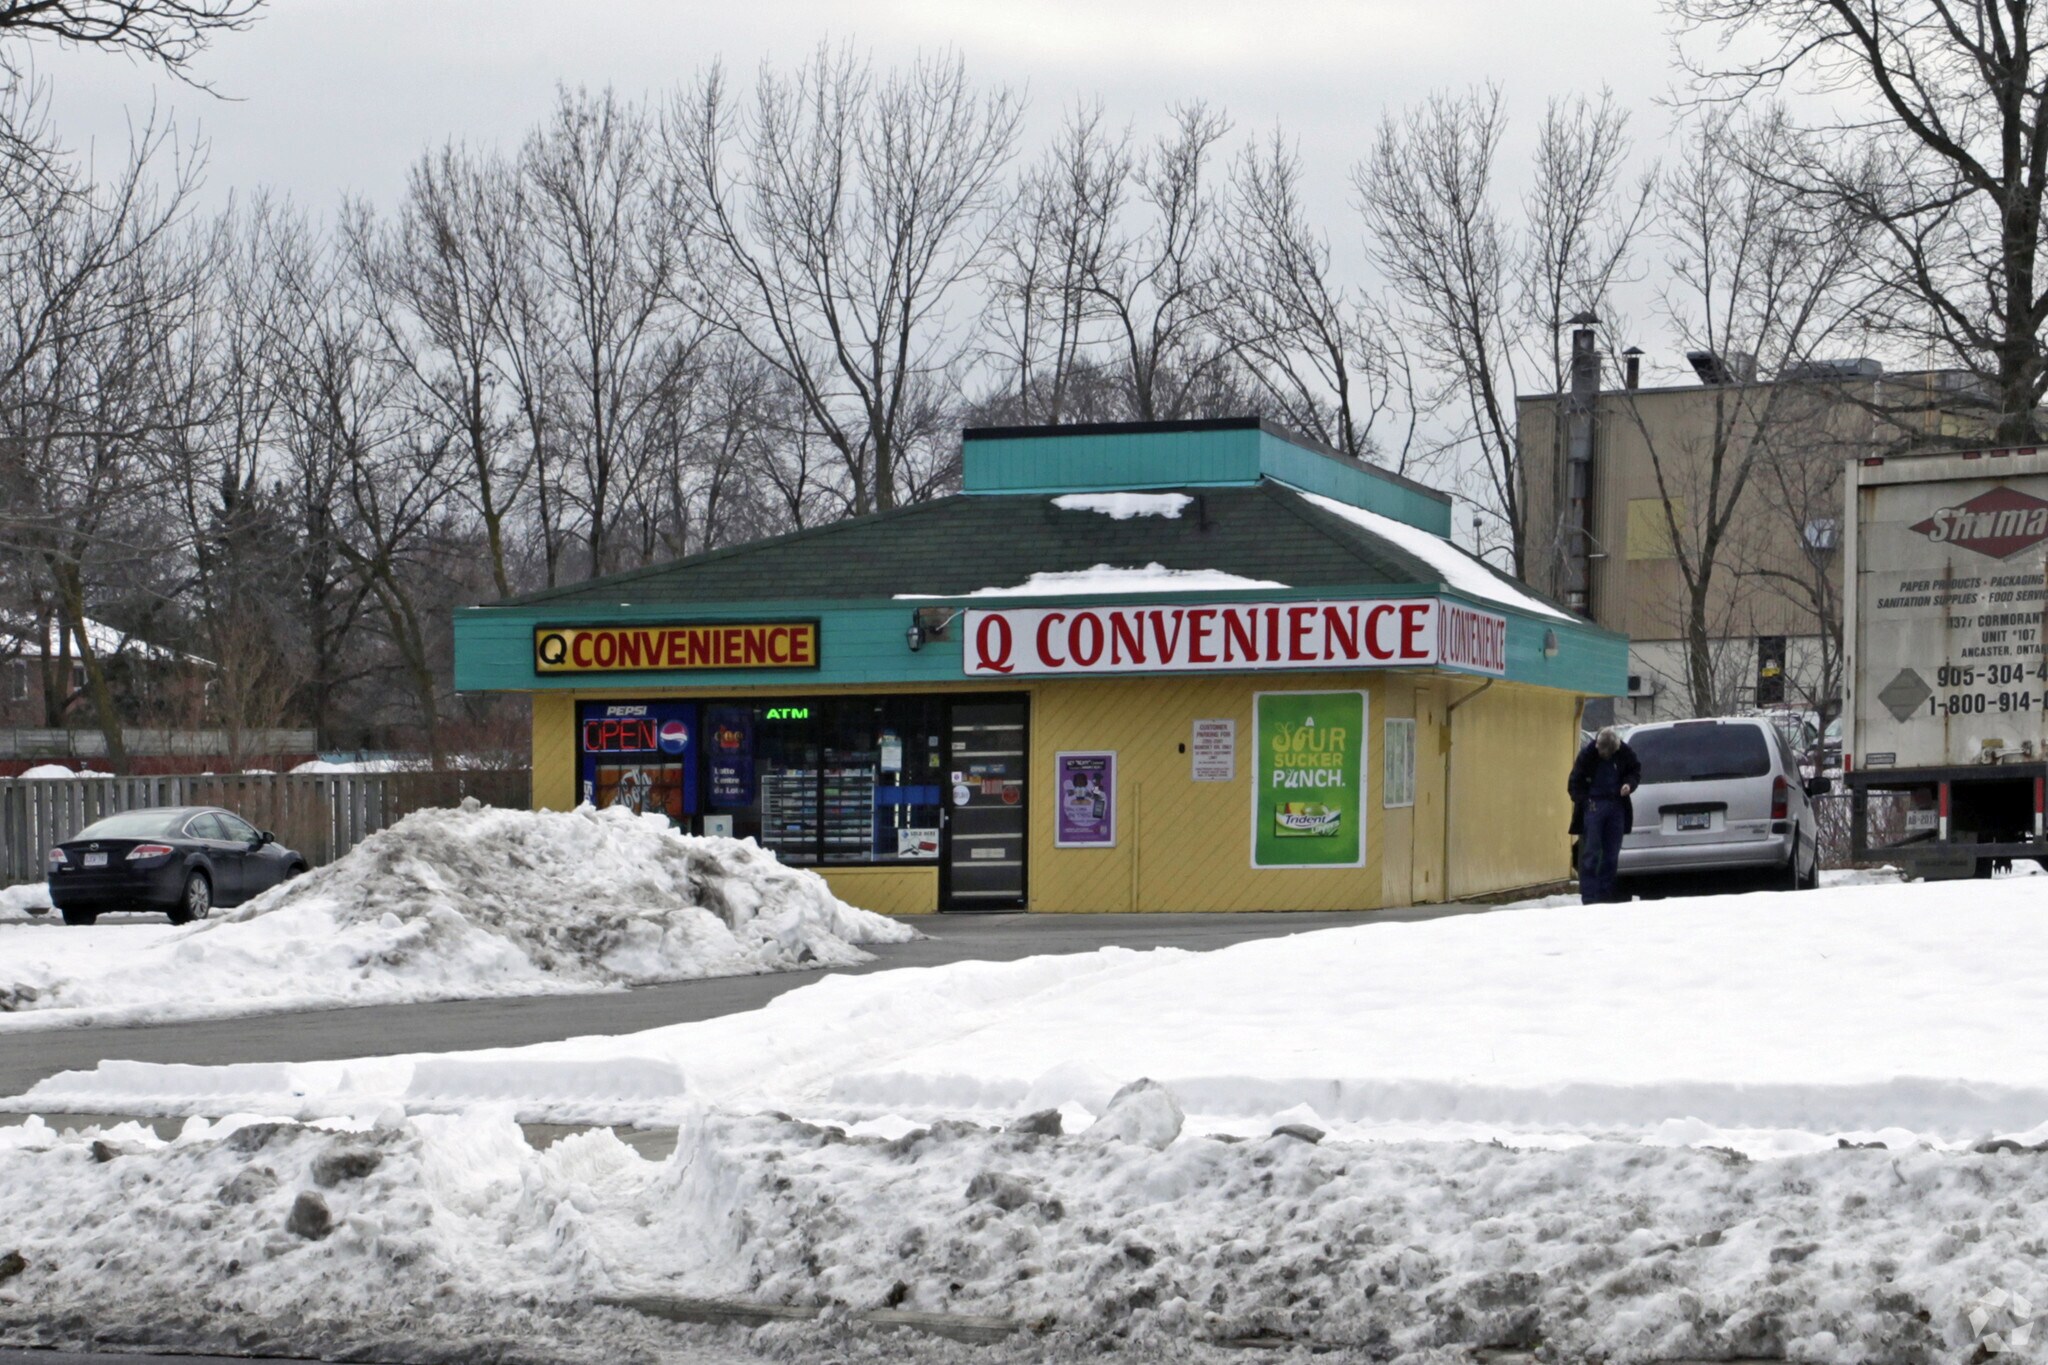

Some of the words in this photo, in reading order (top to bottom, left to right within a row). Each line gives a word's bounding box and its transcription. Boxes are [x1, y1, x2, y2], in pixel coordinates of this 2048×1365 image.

[1900, 580, 1930, 592] PAPER
[1932, 578, 1981, 590] PRODUCTS
[1990, 574, 2045, 587] PACKAGING
[1877, 596, 1930, 609] SANITATION
[1933, 593, 1978, 606] SUPPLIES
[1989, 591, 2014, 603] FOOD
[975, 613, 1015, 673] Q
[1036, 604, 1431, 667] CONVENIENCE
[1440, 604, 1447, 664] Q
[1450, 606, 1505, 670] CONVENIENCE
[1982, 630, 2007, 643] UNIT
[539, 633, 566, 665] Q
[572, 627, 809, 667] CONVENIENCE
[606, 706, 648, 716] PEPSI
[766, 708, 808, 719] ATM
[1305, 716, 1315, 727] A
[586, 719, 656, 750] OPEN
[1272, 722, 1347, 752] SOUR
[1274, 752, 1344, 768] SUCKER
[1273, 768, 1346, 788] PUNCH.
[1285, 814, 1327, 825] Trident
